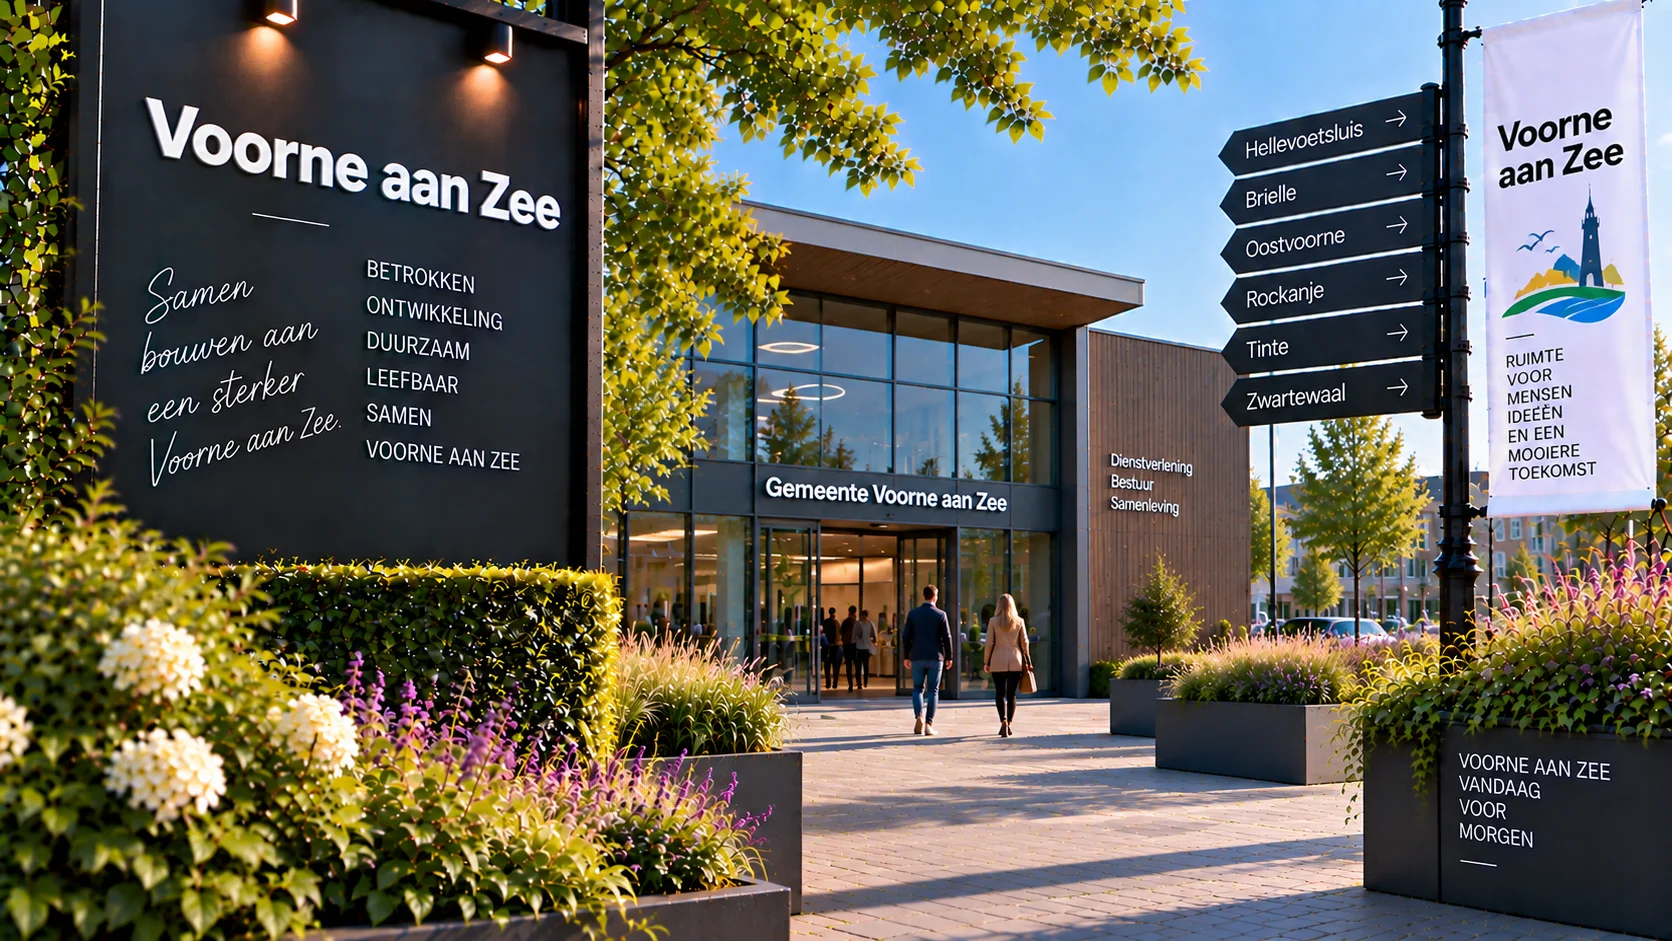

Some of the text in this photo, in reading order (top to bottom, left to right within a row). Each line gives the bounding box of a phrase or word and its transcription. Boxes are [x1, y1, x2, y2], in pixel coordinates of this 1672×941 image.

[1245, 120, 1364, 159] Hellevoetsluis
[1497, 107, 1613, 152] Voorne
[145, 96, 561, 230] Voorne aan Zee
[1498, 142, 1624, 189] aan Zee
[1246, 184, 1297, 209] Brielle
[1245, 228, 1346, 259] Oostvoorne
[367, 259, 475, 294] BETROKKEN
[144, 266, 255, 325] Samen
[1247, 281, 1325, 308] Rockanje
[366, 295, 503, 331] ONTWIKKELING
[141, 322, 319, 375] bouwen aan
[367, 330, 470, 361] DUURZAAM
[1246, 339, 1289, 359] Tinte
[1506, 347, 1564, 368] RUIMTE
[367, 367, 459, 394] LEEFBAAR
[1507, 368, 1553, 386] VOOR
[147, 360, 308, 423] een sterker
[1246, 382, 1346, 411] Zwartewaal
[1507, 384, 1573, 406] MENSEN
[366, 402, 432, 427] SAMEN
[150, 406, 342, 488] Voorne aan Zee.
[1508, 424, 1564, 444] EN EEN
[366, 439, 520, 471] VOORNE AAN ZEE
[1111, 452, 1193, 479] Dienstverlening
[1508, 443, 1580, 463] MOOIERE
[1111, 473, 1155, 491] Bestuur
[1508, 459, 1597, 481] TOEKOMST
[765, 476, 1008, 512] Gemeente Voorne aan Zee
[1110, 495, 1180, 518] Samenleving
[1458, 752, 1611, 781] VOORNE AAN ZEE
[1458, 775, 1541, 800] VANDAAG
[1459, 798, 1507, 820] VOOR
[1459, 822, 1533, 848] MORGEN
